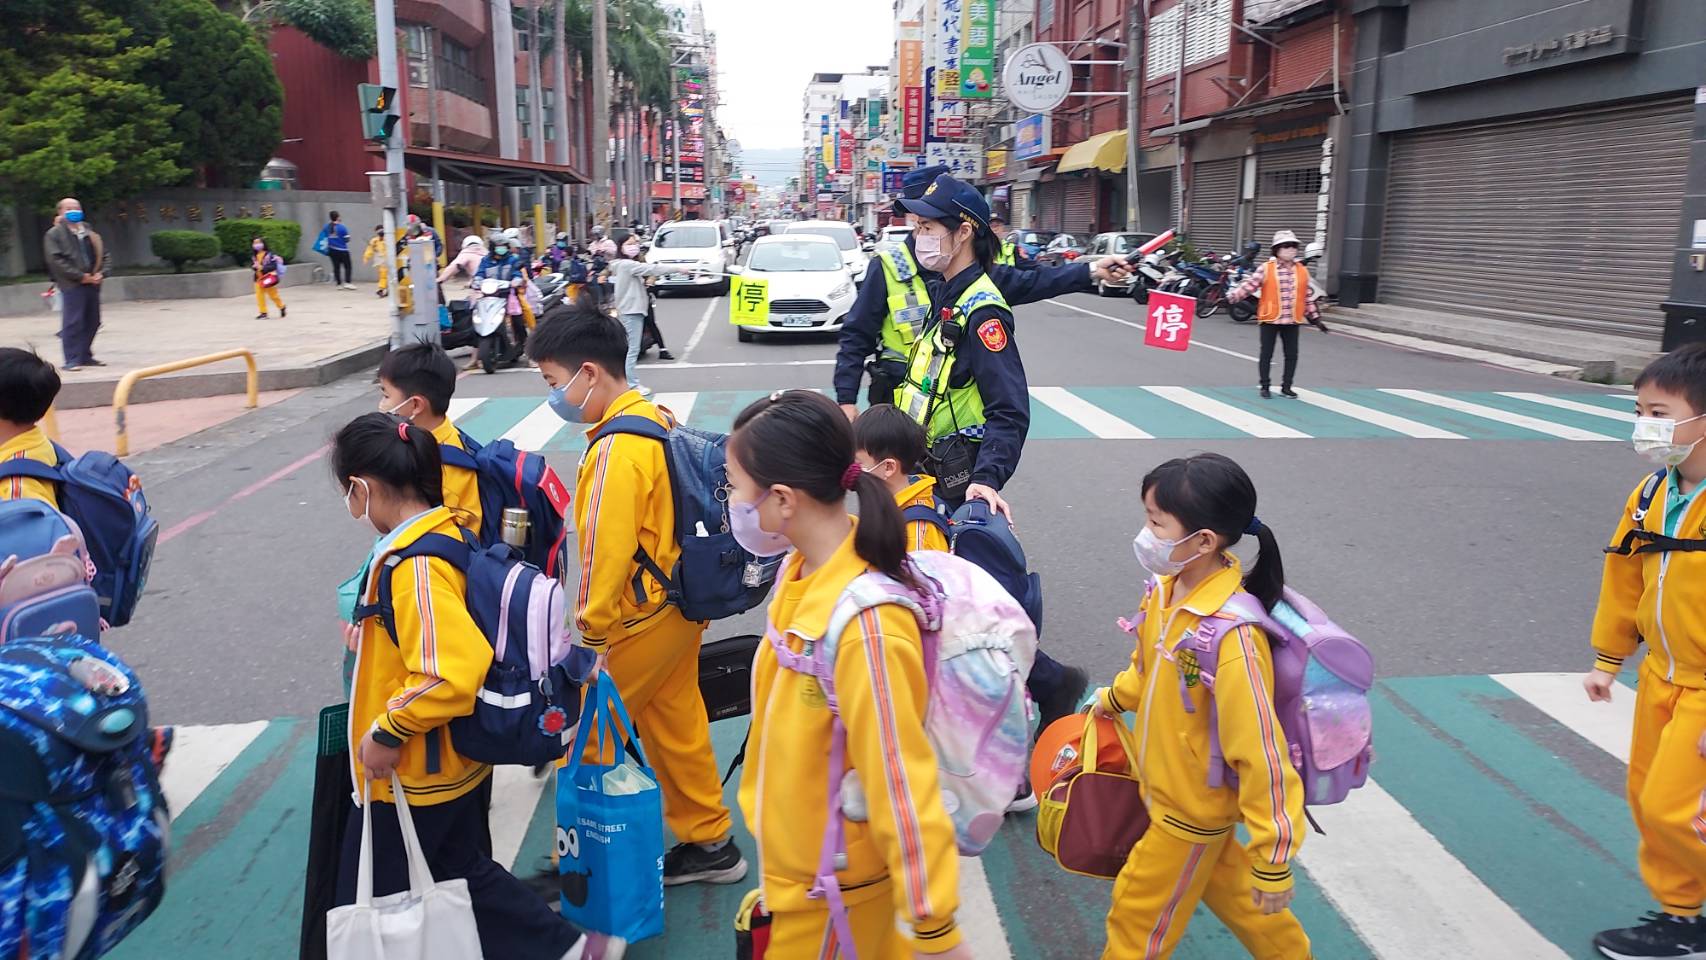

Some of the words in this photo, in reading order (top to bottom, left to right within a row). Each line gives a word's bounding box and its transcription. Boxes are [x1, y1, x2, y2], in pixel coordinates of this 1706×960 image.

[1012, 70, 1062, 89] Angel
[736, 281, 765, 312] 停
[1151, 303, 1189, 342] 停
[944, 469, 969, 484] POLICE
[597, 823, 627, 833] STREET
